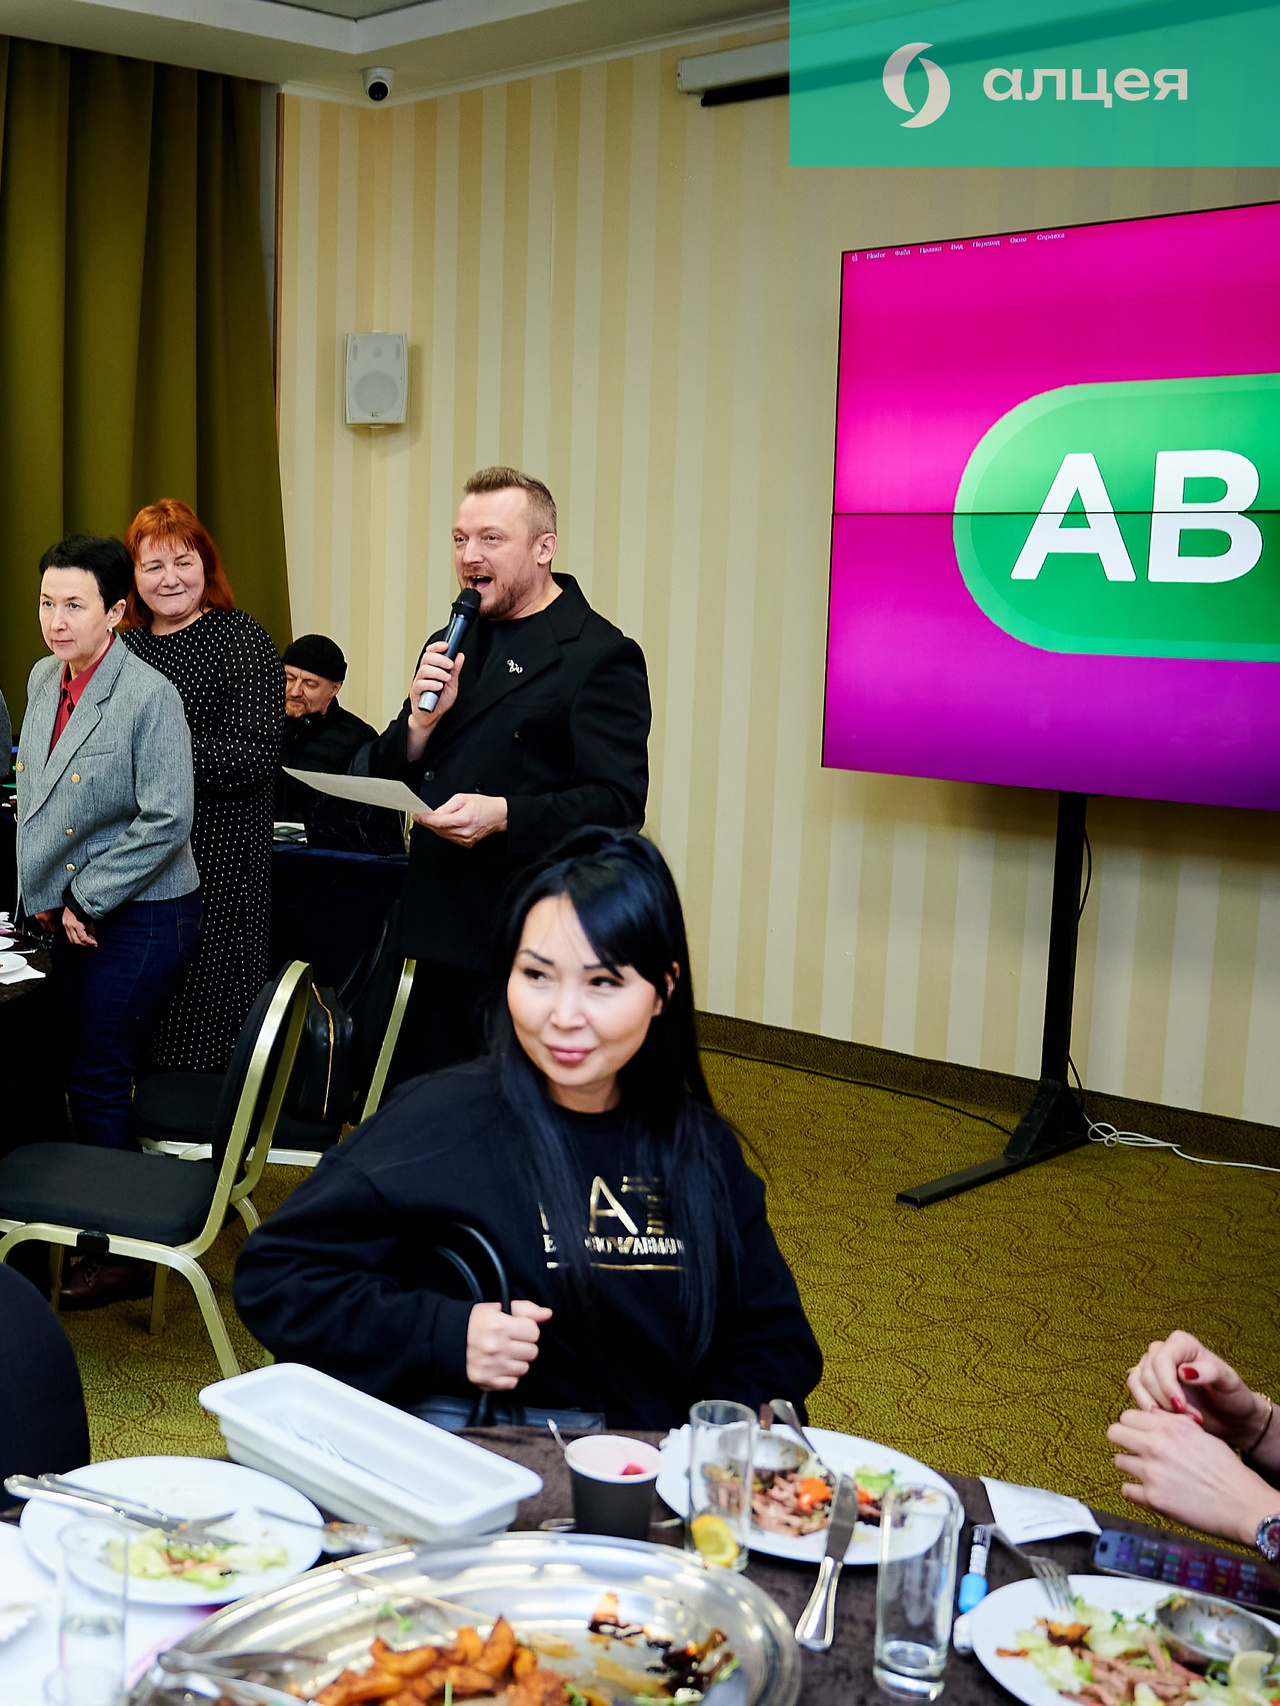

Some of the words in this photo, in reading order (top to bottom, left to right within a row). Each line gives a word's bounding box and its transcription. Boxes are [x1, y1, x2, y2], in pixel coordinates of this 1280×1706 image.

[894, 248, 911, 256] Файл
[919, 246, 942, 254] Правка
[1036, 233, 1065, 241] Справка
